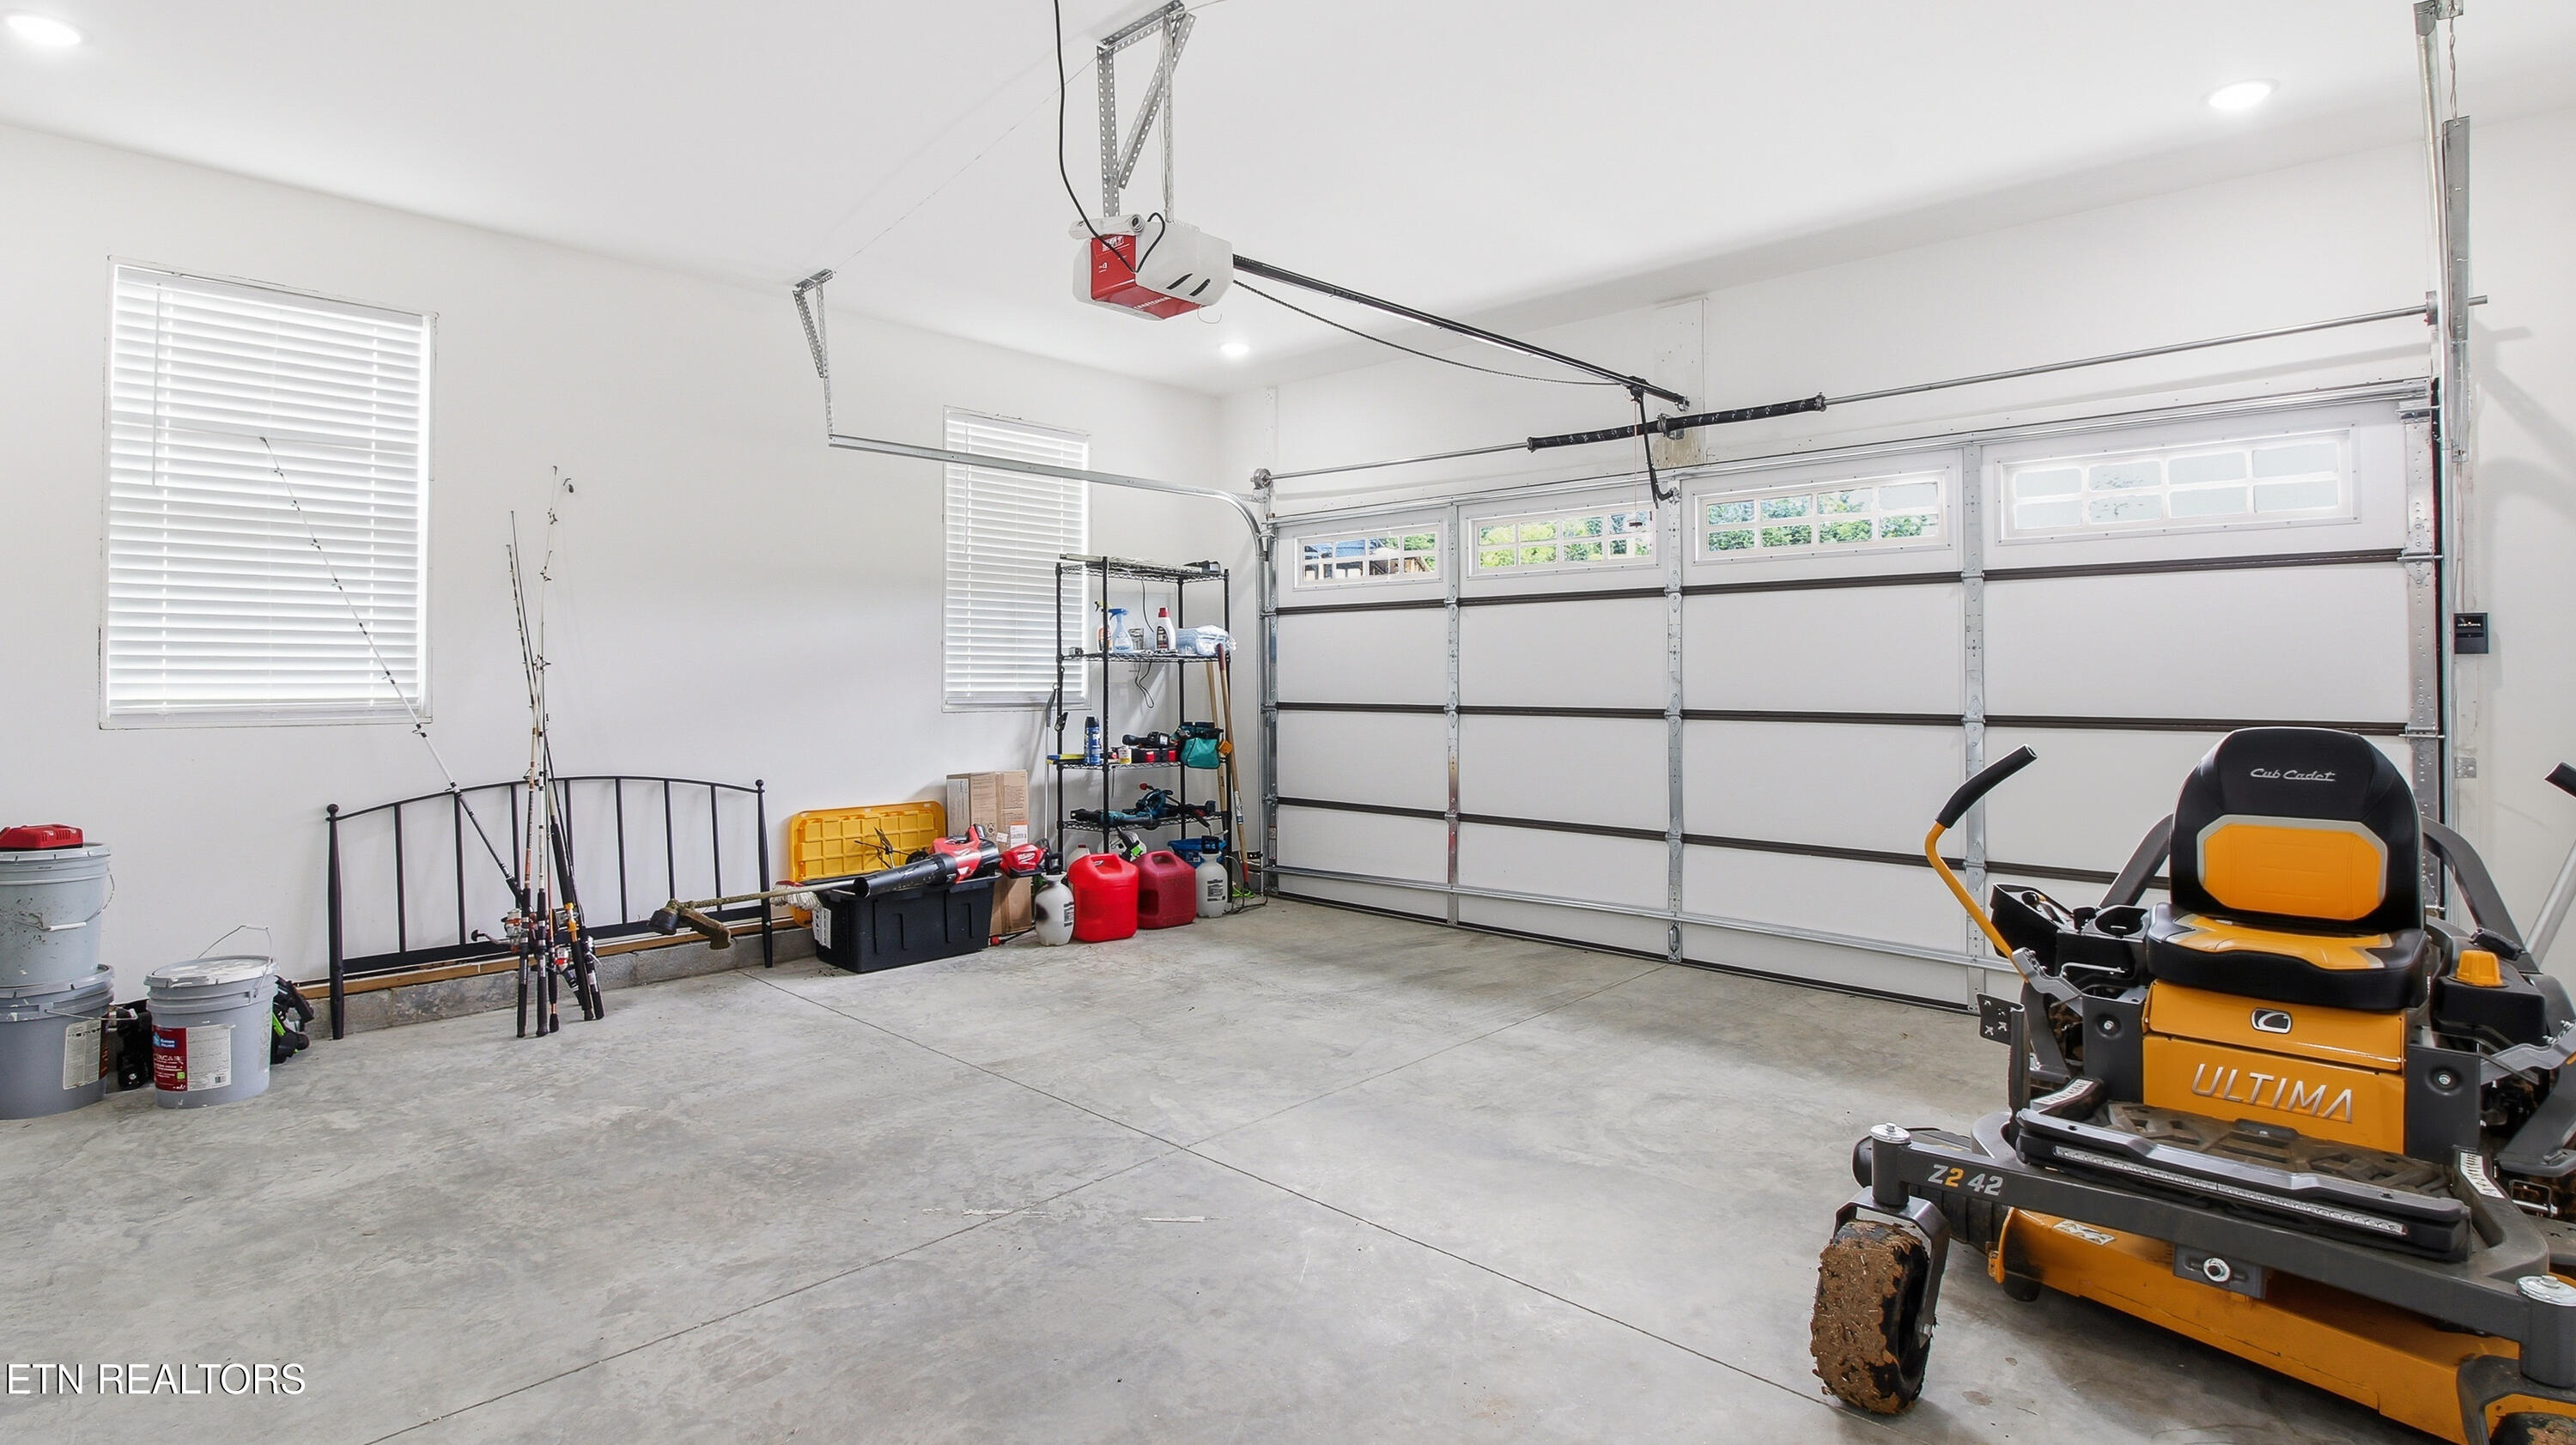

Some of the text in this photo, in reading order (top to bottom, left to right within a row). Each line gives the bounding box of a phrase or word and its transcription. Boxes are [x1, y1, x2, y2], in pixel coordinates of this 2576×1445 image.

[2250, 768, 2336, 781] Cub Cadet
[2190, 1063, 2353, 1123] ULTIMA
[1927, 1163, 2003, 1196] Z2 42
